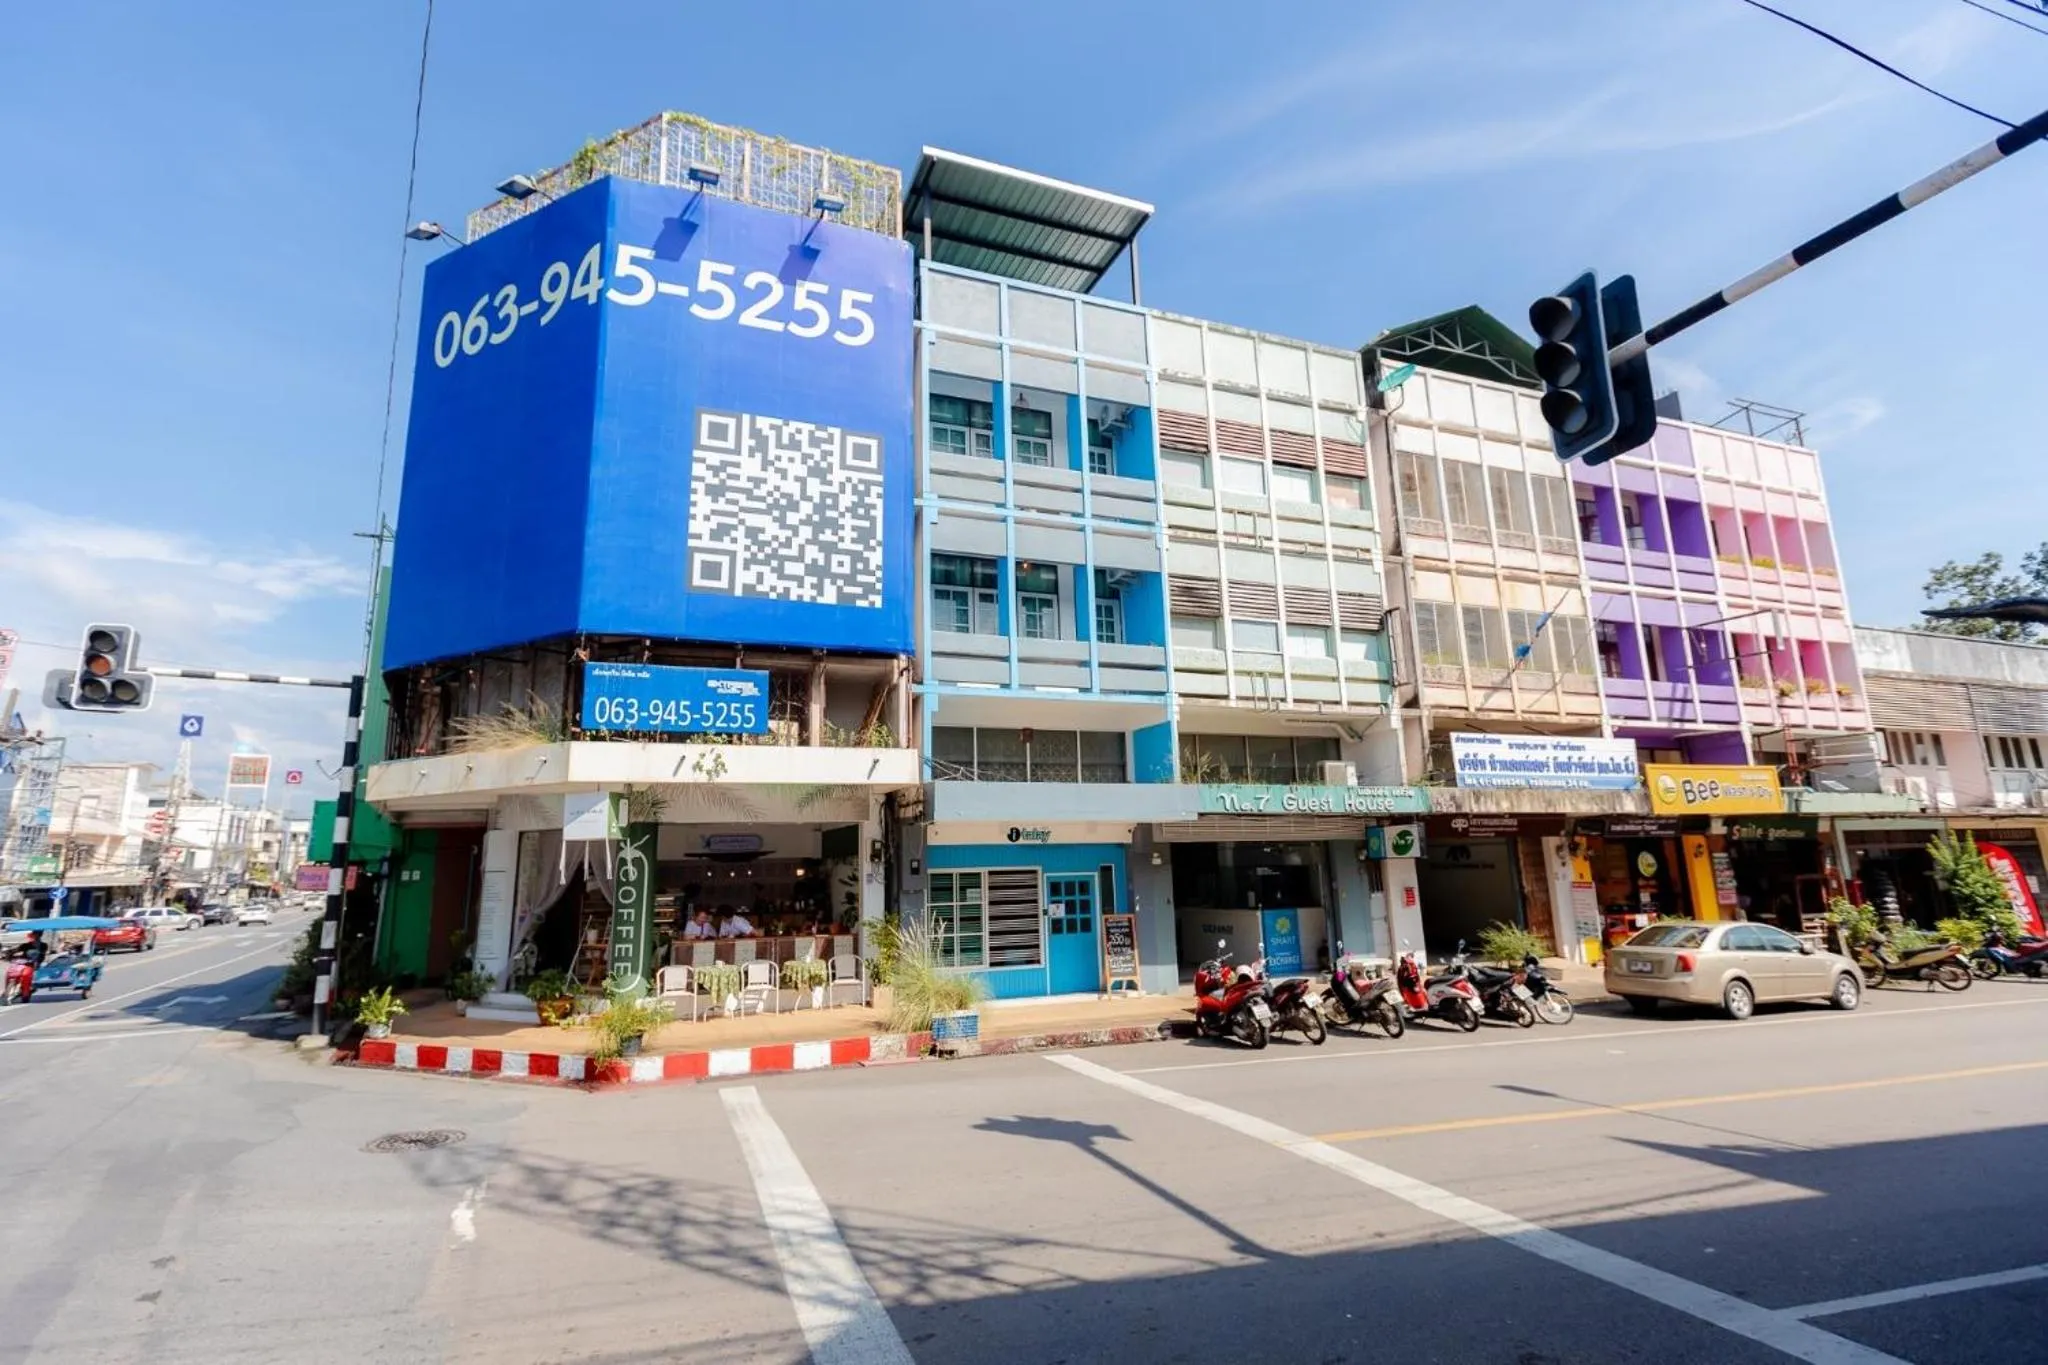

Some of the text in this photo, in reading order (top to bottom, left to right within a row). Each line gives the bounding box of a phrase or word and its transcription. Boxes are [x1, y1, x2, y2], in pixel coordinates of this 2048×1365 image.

[433, 242, 876, 369] 063-945-5255
[594, 696, 757, 729] 063-945-5255
[1282, 792, 1335, 812] Guest
[1344, 792, 1395, 812] House
[1681, 778, 1721, 805] Bee
[613, 866, 639, 978] COFFEE
[1270, 935, 1296, 946] SMART
